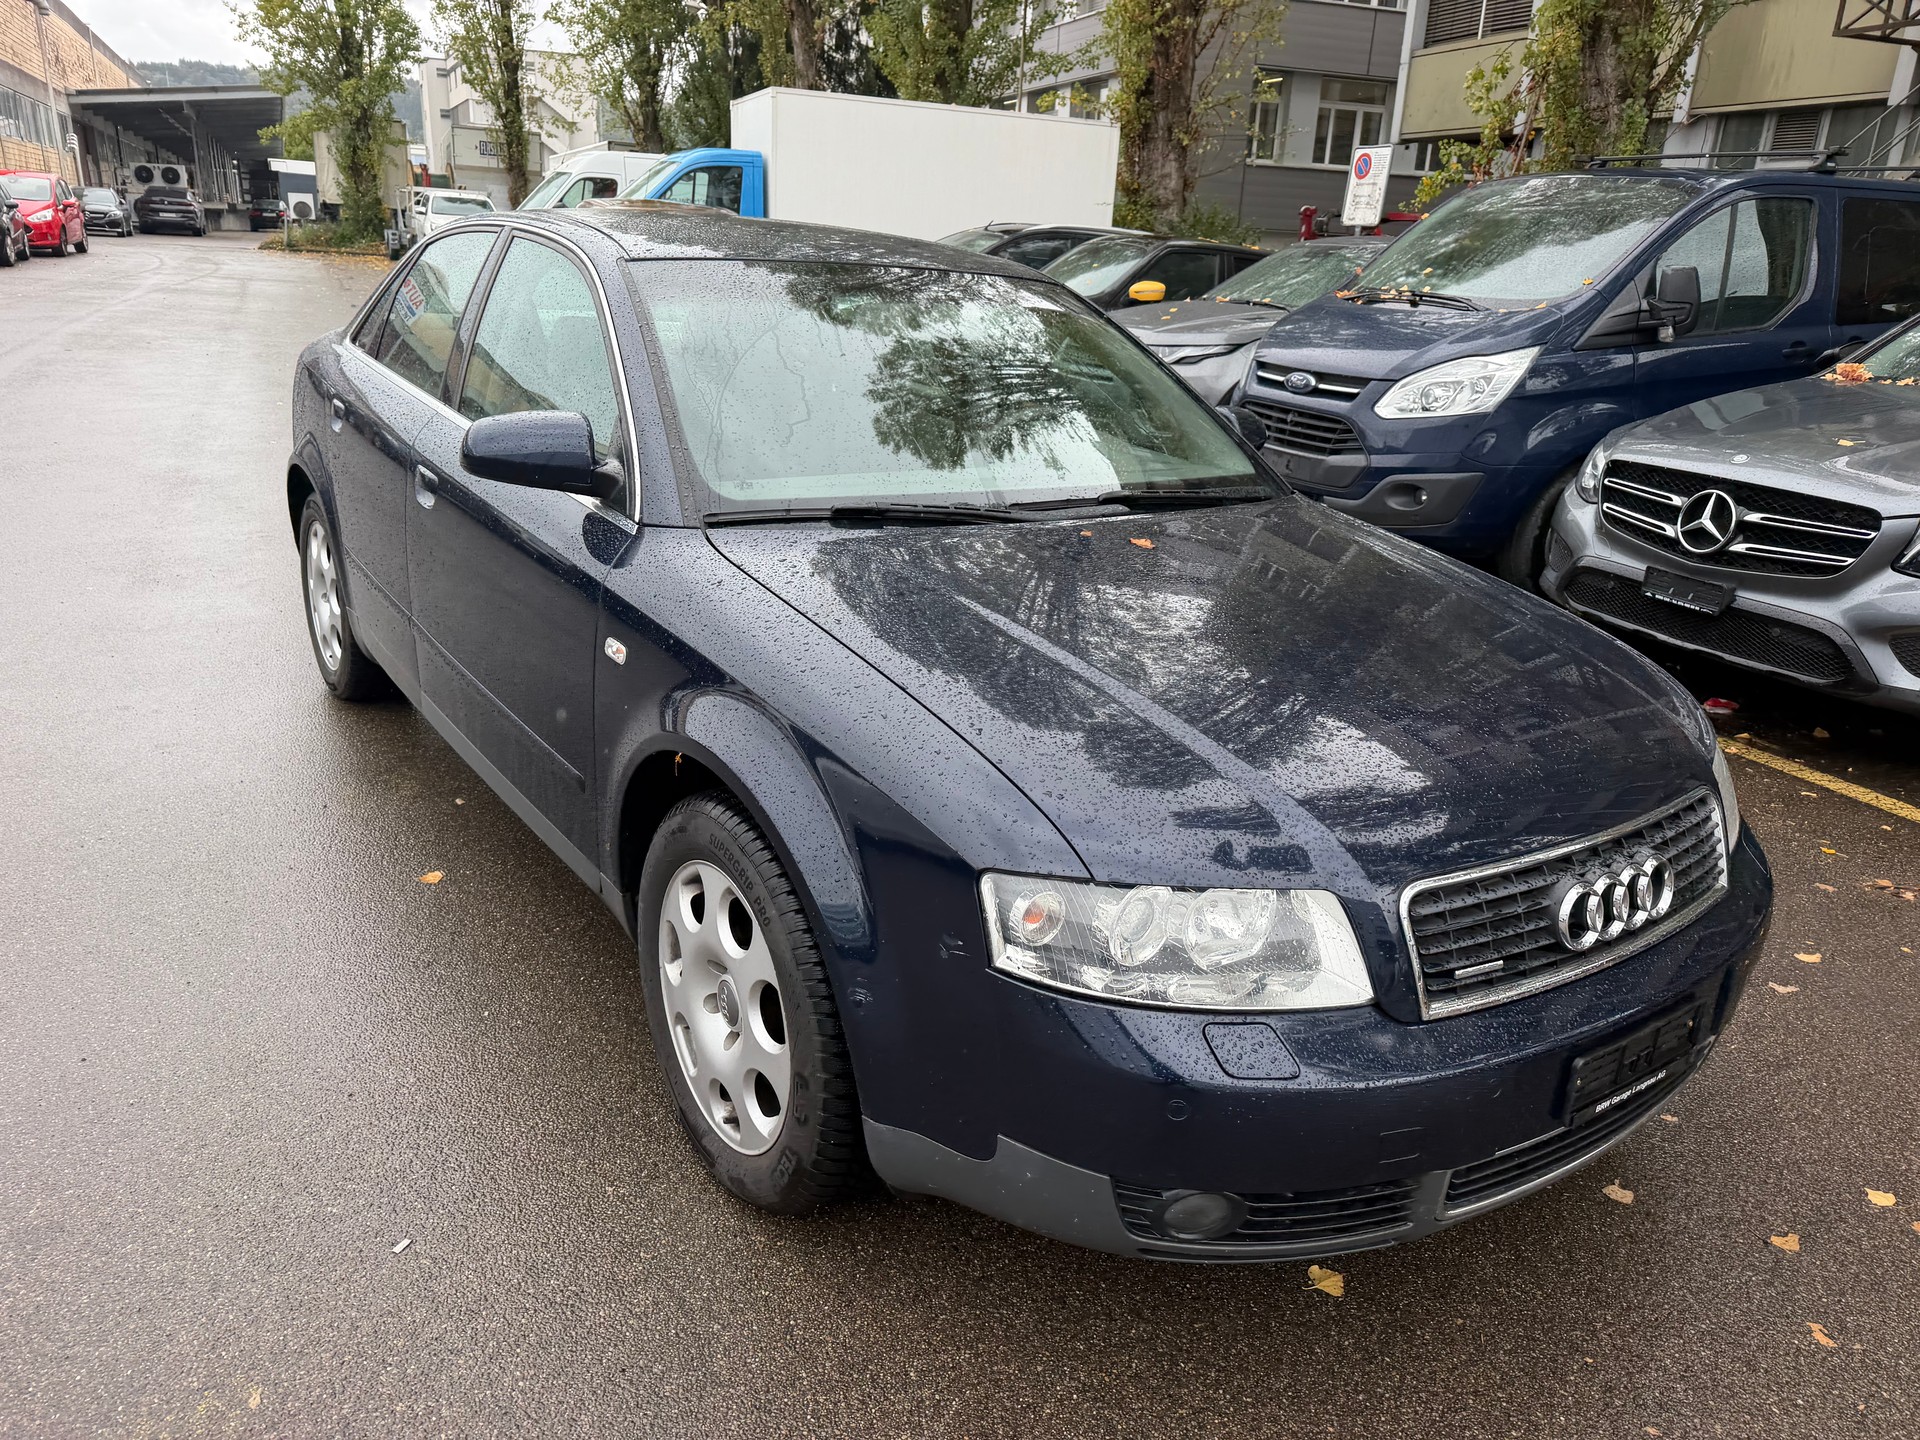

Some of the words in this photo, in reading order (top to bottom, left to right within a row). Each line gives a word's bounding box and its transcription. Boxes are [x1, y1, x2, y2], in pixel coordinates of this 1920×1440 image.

[709, 833, 754, 891] SUPERGRIP
[753, 896, 771, 927] PRO
[1611, 1089, 1632, 1105] Garage
[1656, 1069, 1667, 1080] AG
